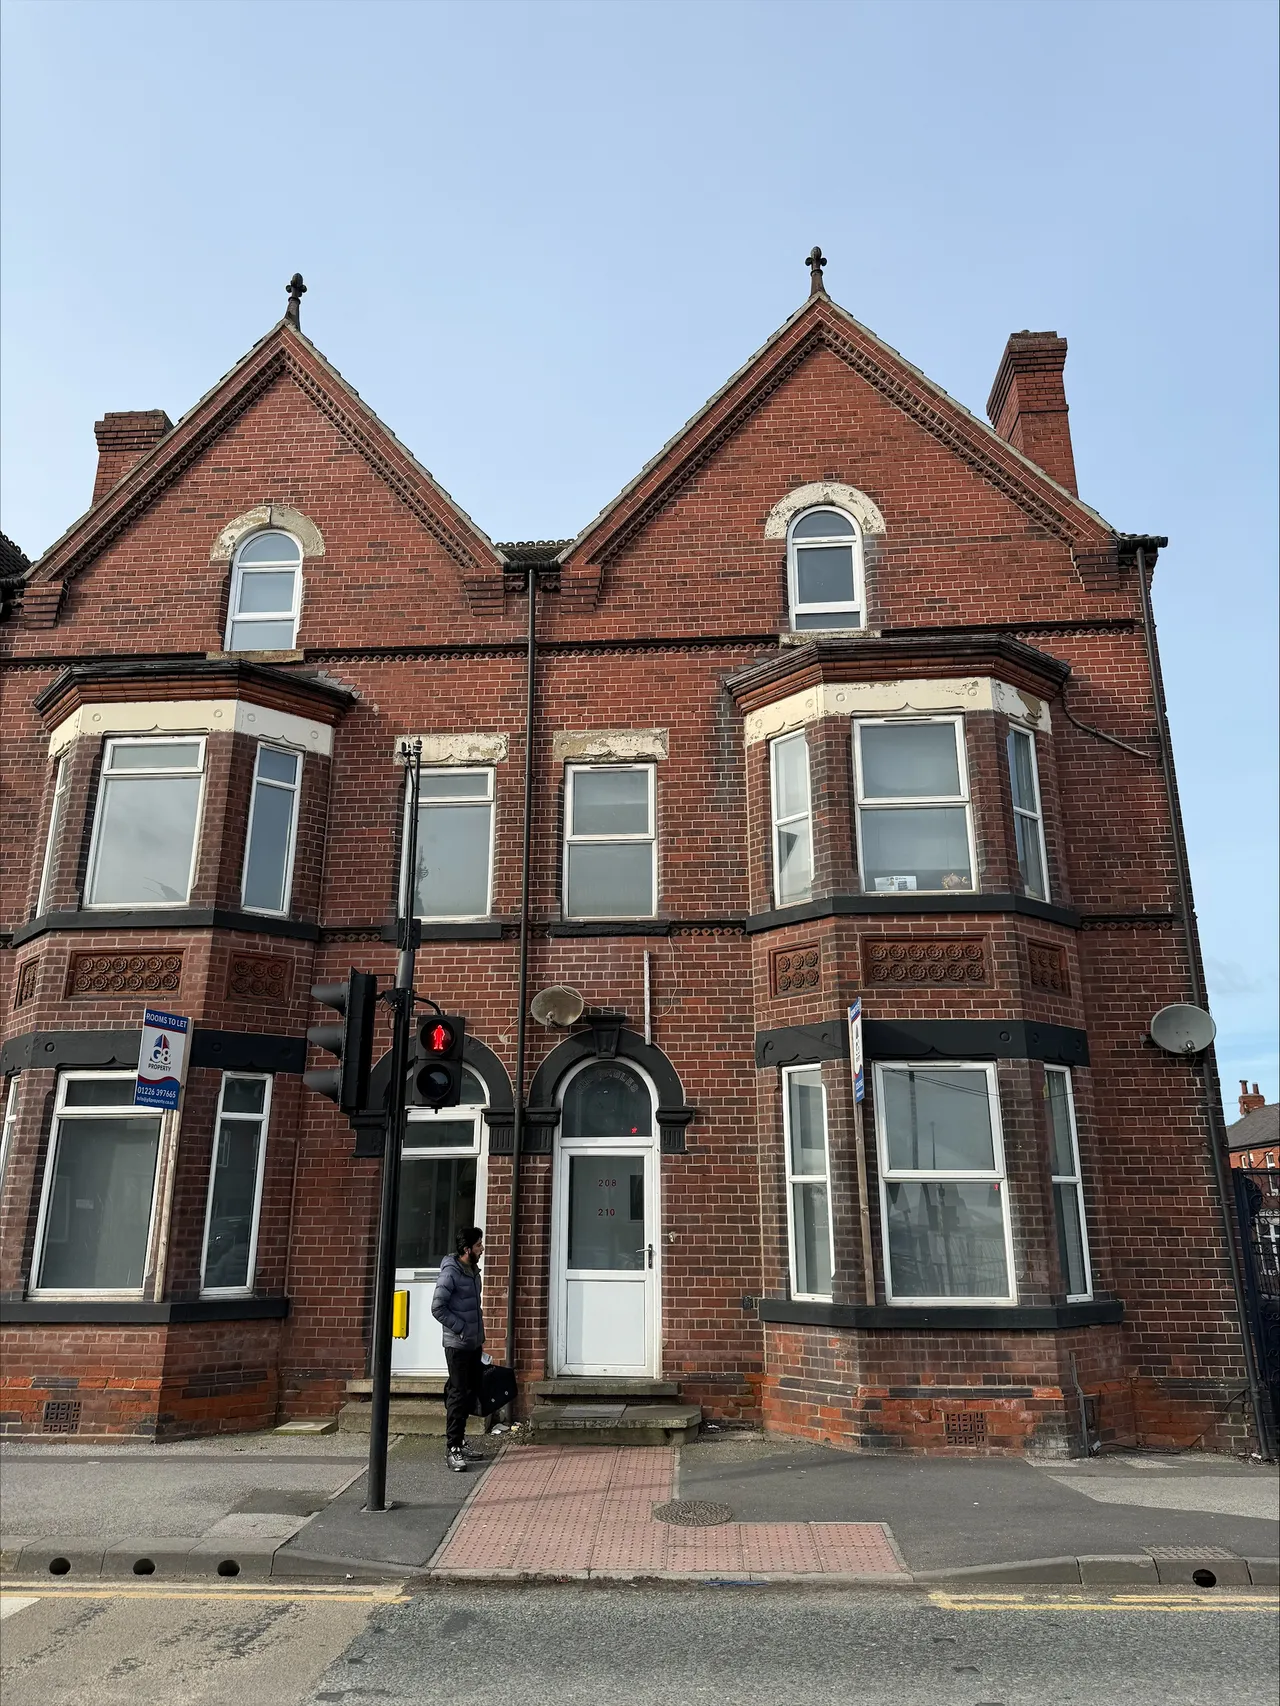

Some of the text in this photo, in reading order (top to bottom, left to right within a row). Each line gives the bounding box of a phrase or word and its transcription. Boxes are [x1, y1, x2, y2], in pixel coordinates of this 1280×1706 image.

[146, 1012, 187, 1028] ROOMS TO LET
[151, 1046, 171, 1065] G8
[148, 1063, 171, 1072] PROPERTY
[138, 1086, 176, 1098] 01226 397665
[598, 1179, 617, 1187] 208
[598, 1208, 616, 1216] 210
